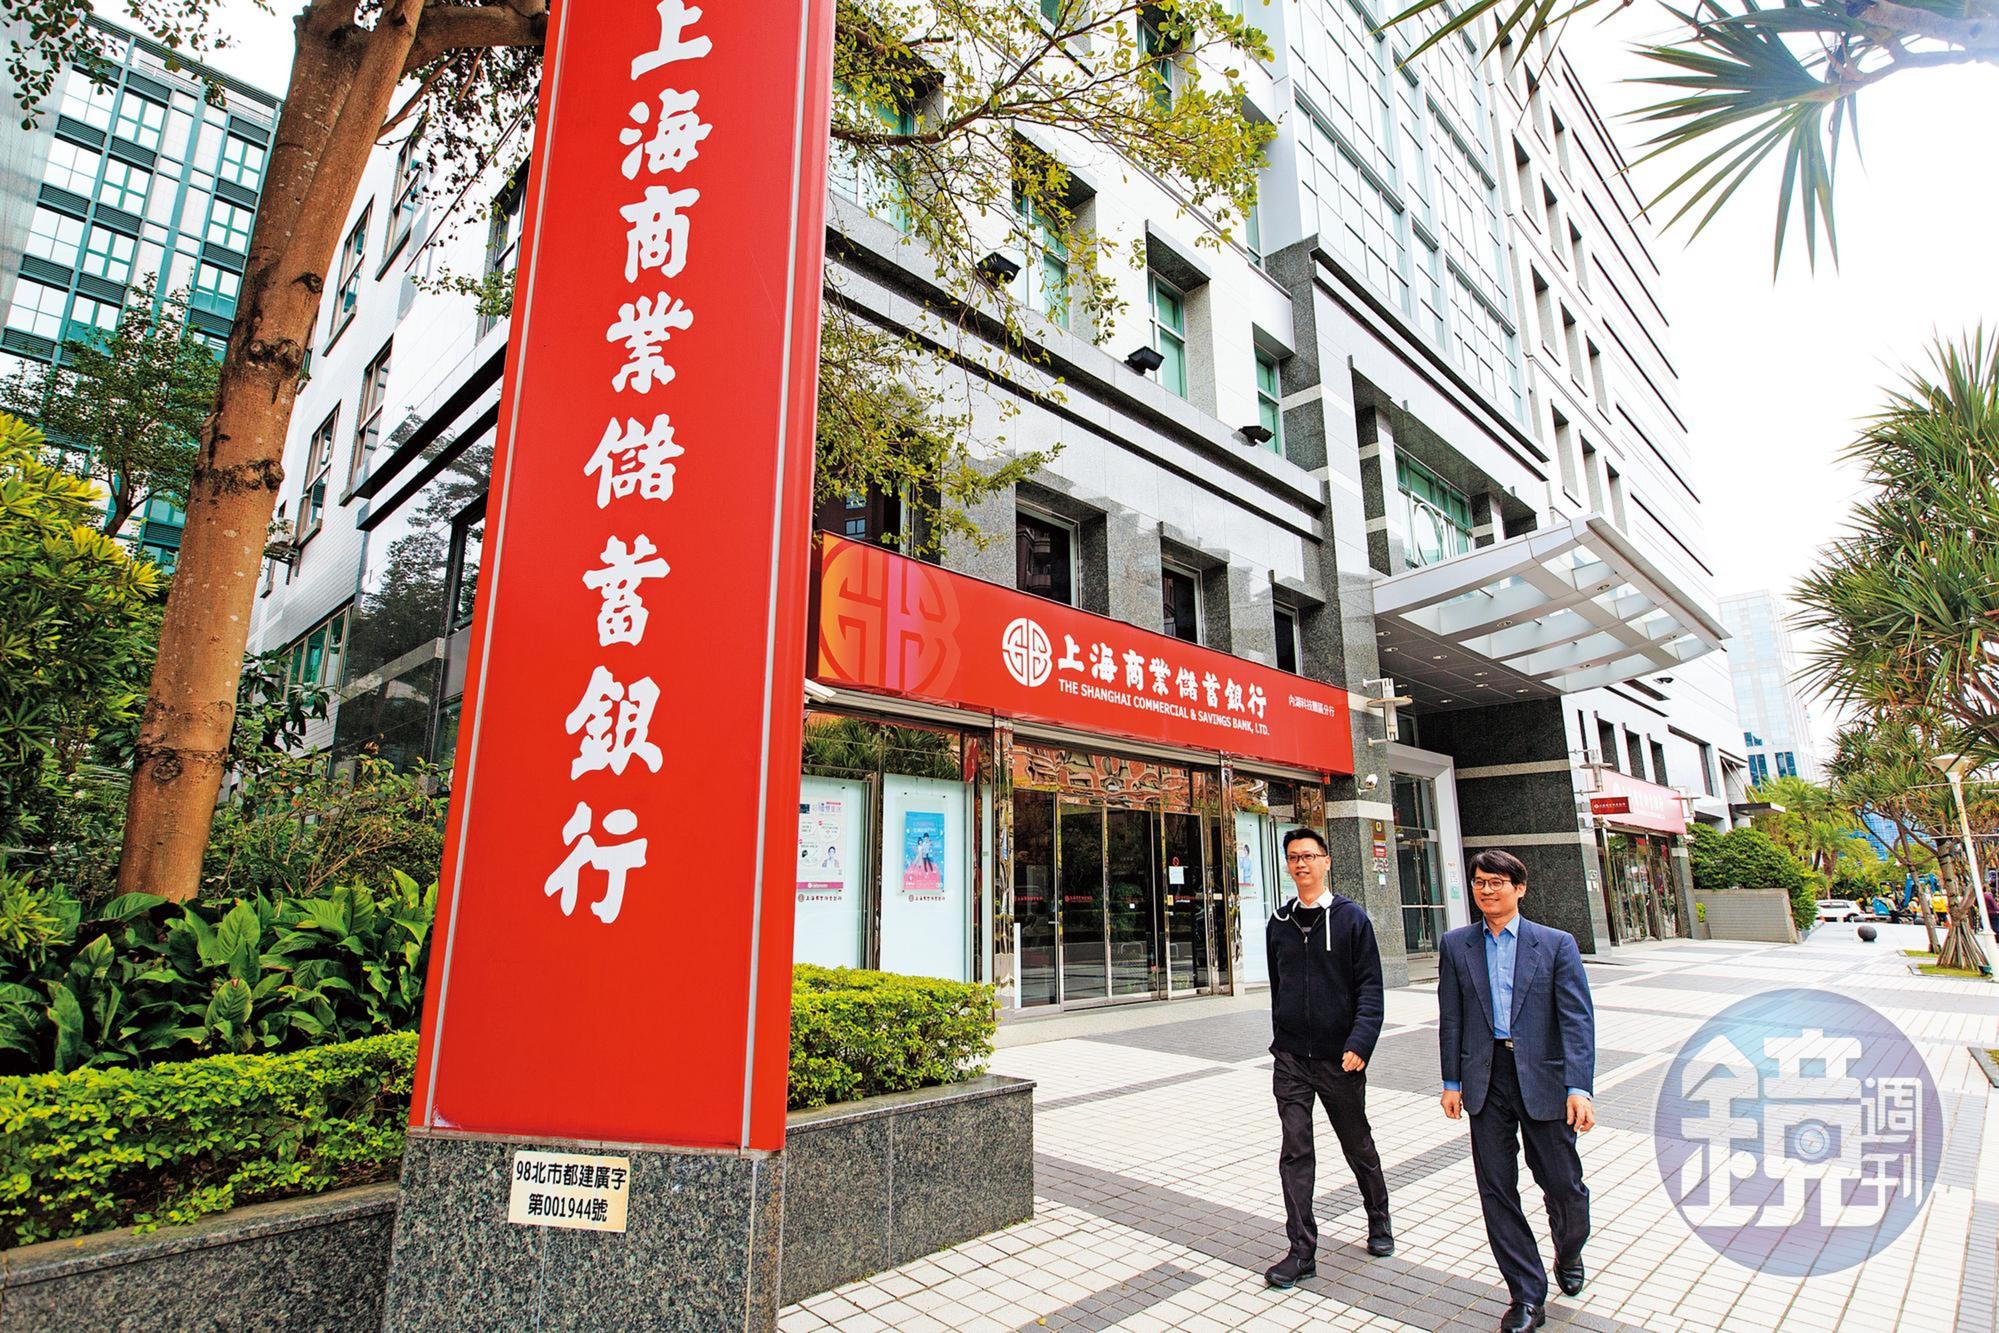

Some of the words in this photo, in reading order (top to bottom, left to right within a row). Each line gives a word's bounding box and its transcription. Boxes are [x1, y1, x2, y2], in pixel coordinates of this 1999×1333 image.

[544, 0, 713, 924] 上海商業儲蓄銀行
[1057, 634, 1267, 719] 上海商業儲蓄銀行
[1058, 678, 1079, 695] THE
[1081, 683, 1132, 707] SHANGHAI
[1133, 697, 1189, 720] COMMERCIAL
[1190, 709, 1197, 720] &
[1197, 710, 1232, 727] SAVINGS
[1232, 717, 1254, 734] BANK,
[1255, 721, 1270, 736] LTD.
[516, 1160, 627, 1190] 98北市都建廣字
[528, 1193, 608, 1222] 第001944號
